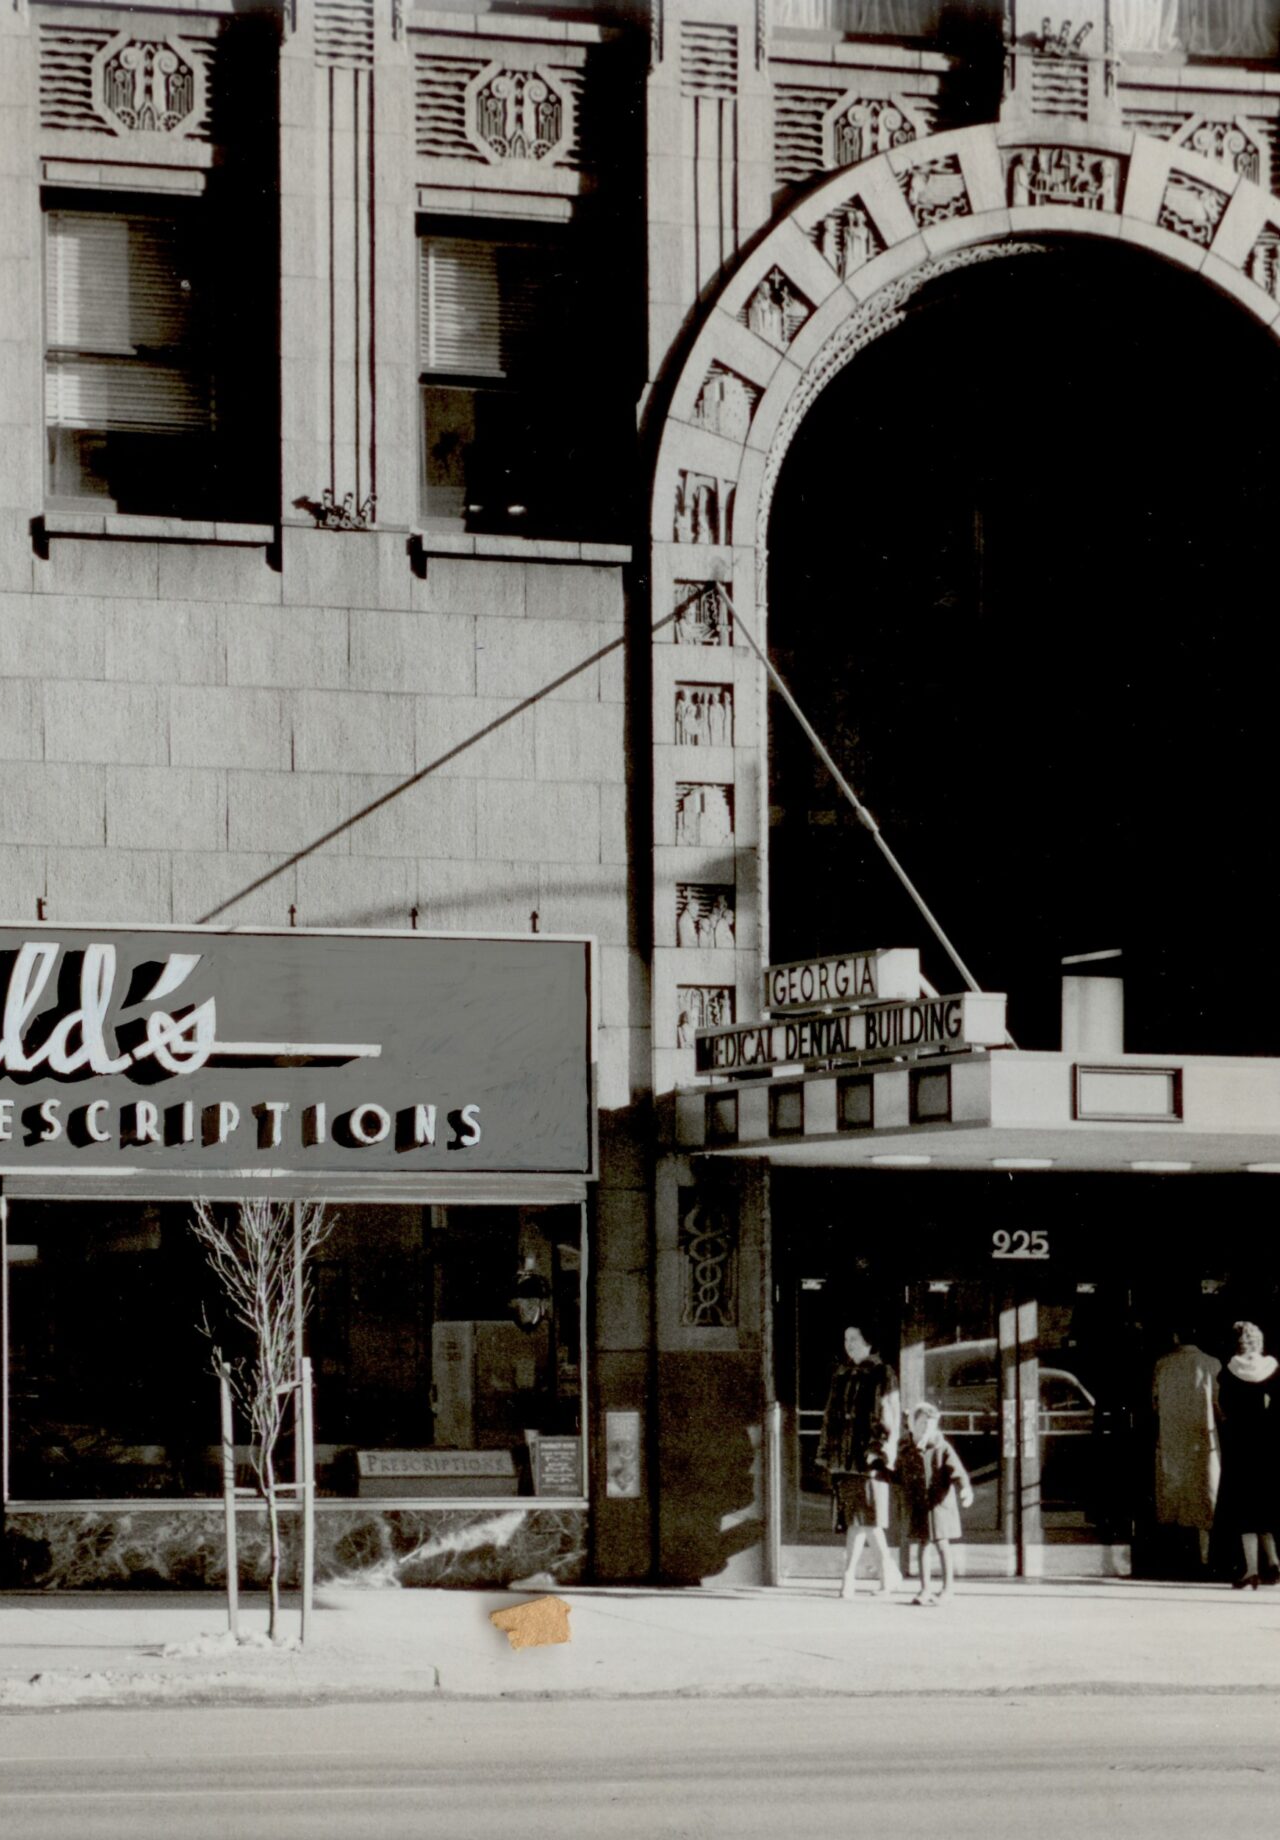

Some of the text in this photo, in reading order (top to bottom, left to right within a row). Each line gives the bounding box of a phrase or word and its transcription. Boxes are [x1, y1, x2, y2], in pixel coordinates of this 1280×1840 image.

[772, 956, 876, 1006] GEORGIA
[785, 1016, 856, 1061] DENTAL
[865, 1002, 962, 1051] BUILDING
[991, 1229, 1050, 1256] 925
